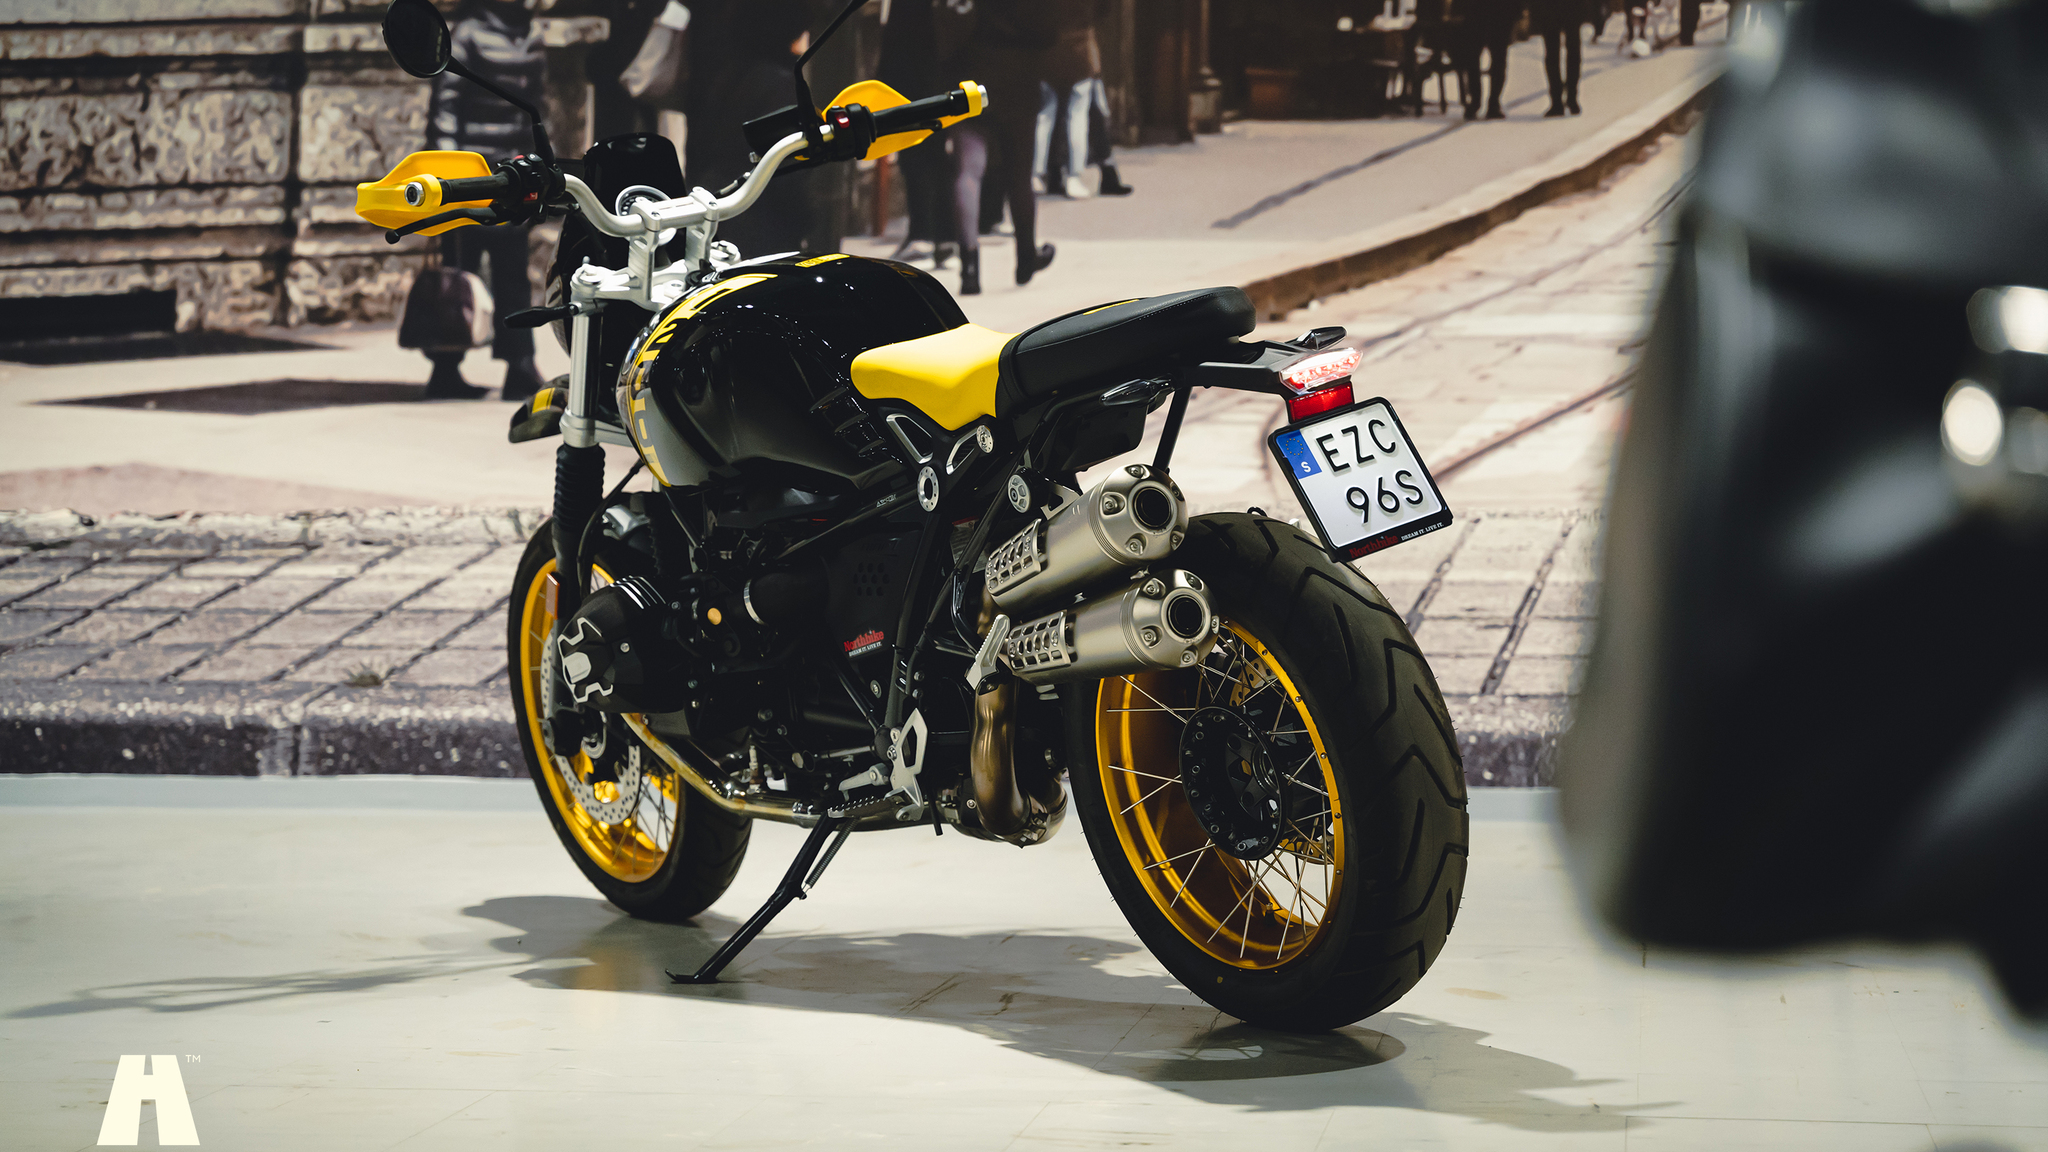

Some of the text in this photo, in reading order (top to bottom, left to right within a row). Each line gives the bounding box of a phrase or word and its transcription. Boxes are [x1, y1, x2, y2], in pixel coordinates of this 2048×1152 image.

[1316, 419, 1397, 473] EZC
[1301, 461, 1312, 473] S
[1345, 469, 1424, 524] 96S
[1349, 535, 1398, 558] Northbike
[1401, 530, 1419, 541] DREAM
[1426, 524, 1437, 532] LIVE
[843, 630, 885, 652] Northbike
